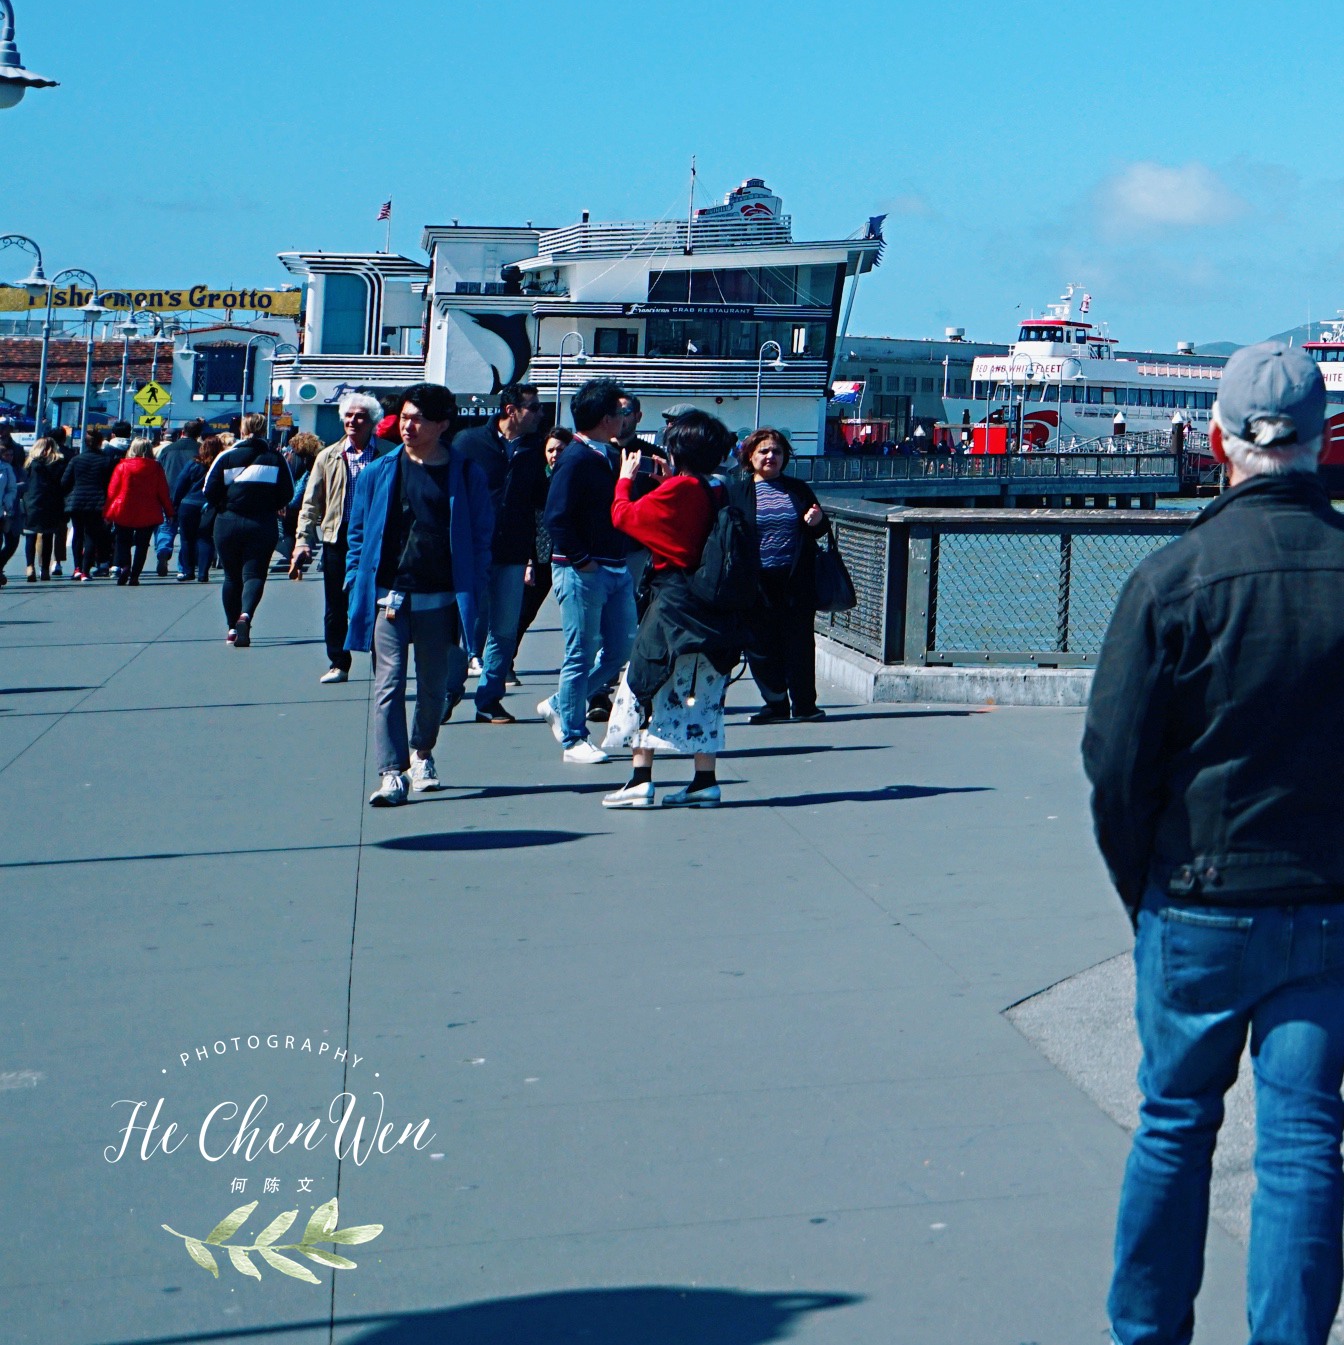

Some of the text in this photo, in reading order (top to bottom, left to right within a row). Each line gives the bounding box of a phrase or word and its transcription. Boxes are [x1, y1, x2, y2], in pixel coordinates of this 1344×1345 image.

[189, 285, 273, 309] Grotto
[1035, 364, 1061, 373] FLEET
[1323, 373, 1343, 382] HITE
